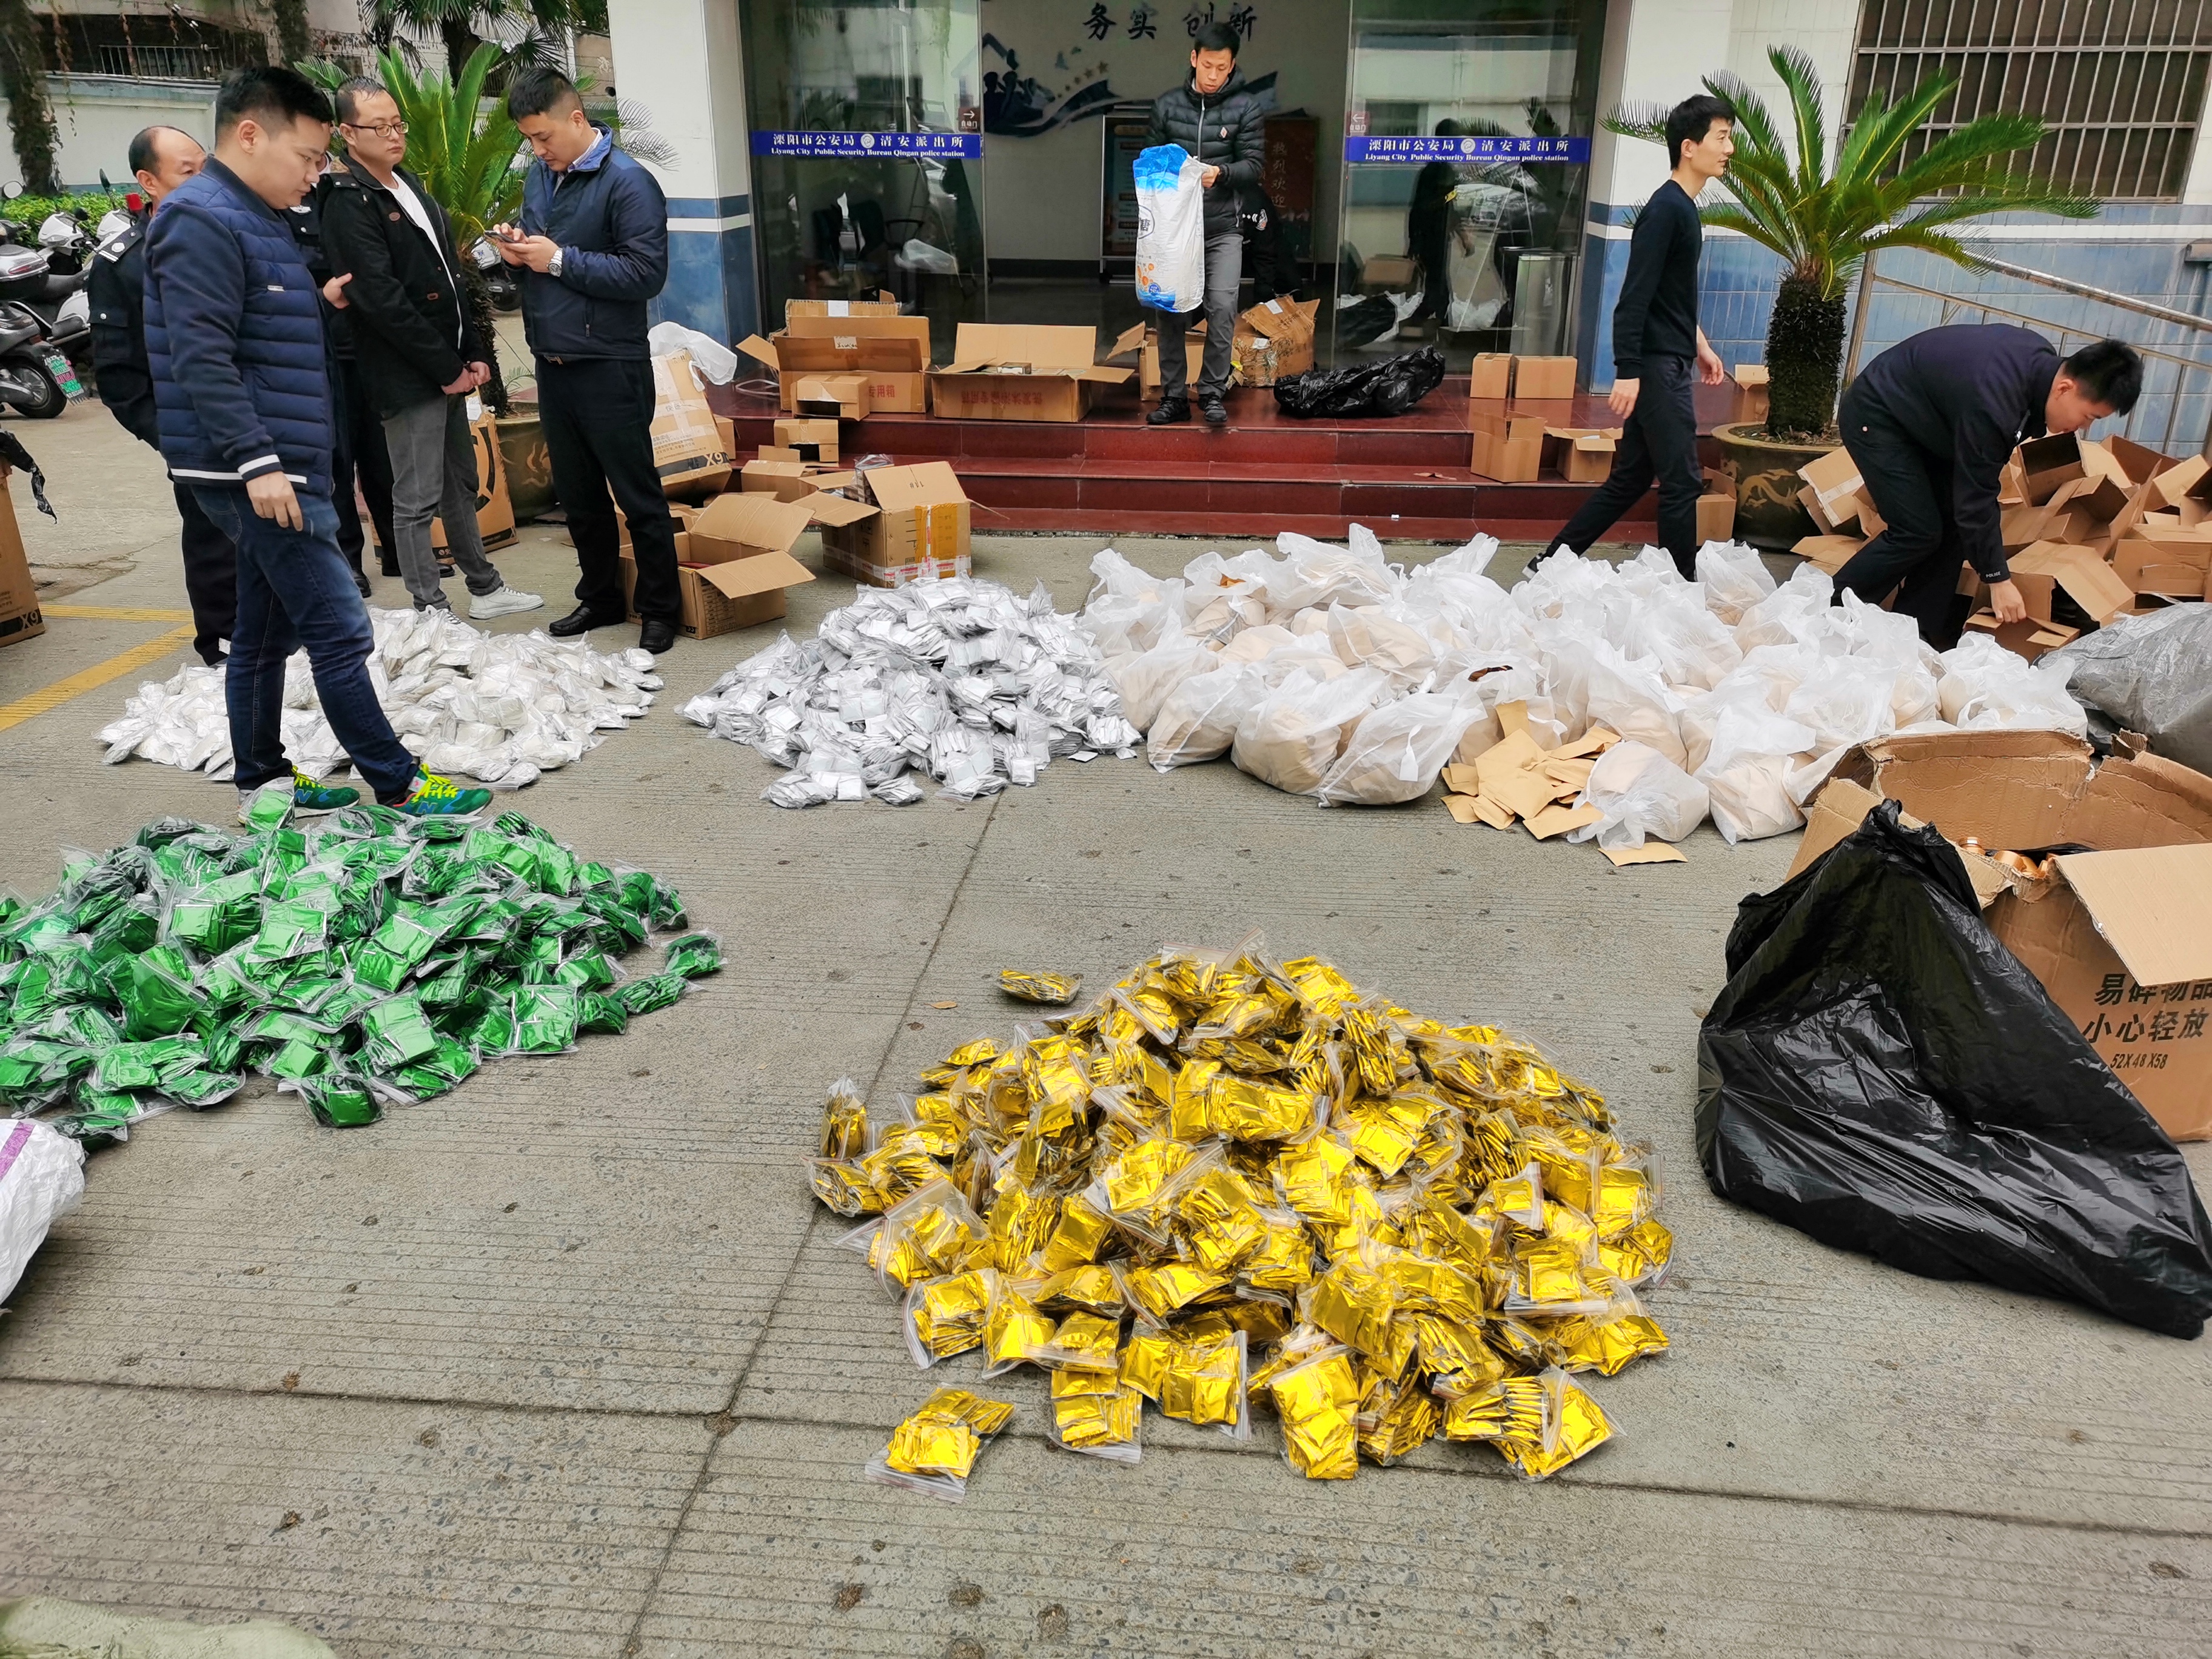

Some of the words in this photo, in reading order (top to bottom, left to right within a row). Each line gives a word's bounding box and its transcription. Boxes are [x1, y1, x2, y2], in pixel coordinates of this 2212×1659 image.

[773, 133, 854, 146] 溧阳市公安局
[880, 135, 963, 148] 清安派出所
[1369, 139, 1454, 152] 溧阳市公安局
[1481, 139, 1569, 152] 清安派出所
[920, 150, 940, 158] police
[704, 451, 724, 468] X9
[20, 611, 39, 631] X9
[2082, 1007, 2209, 1044] 小心轻放
